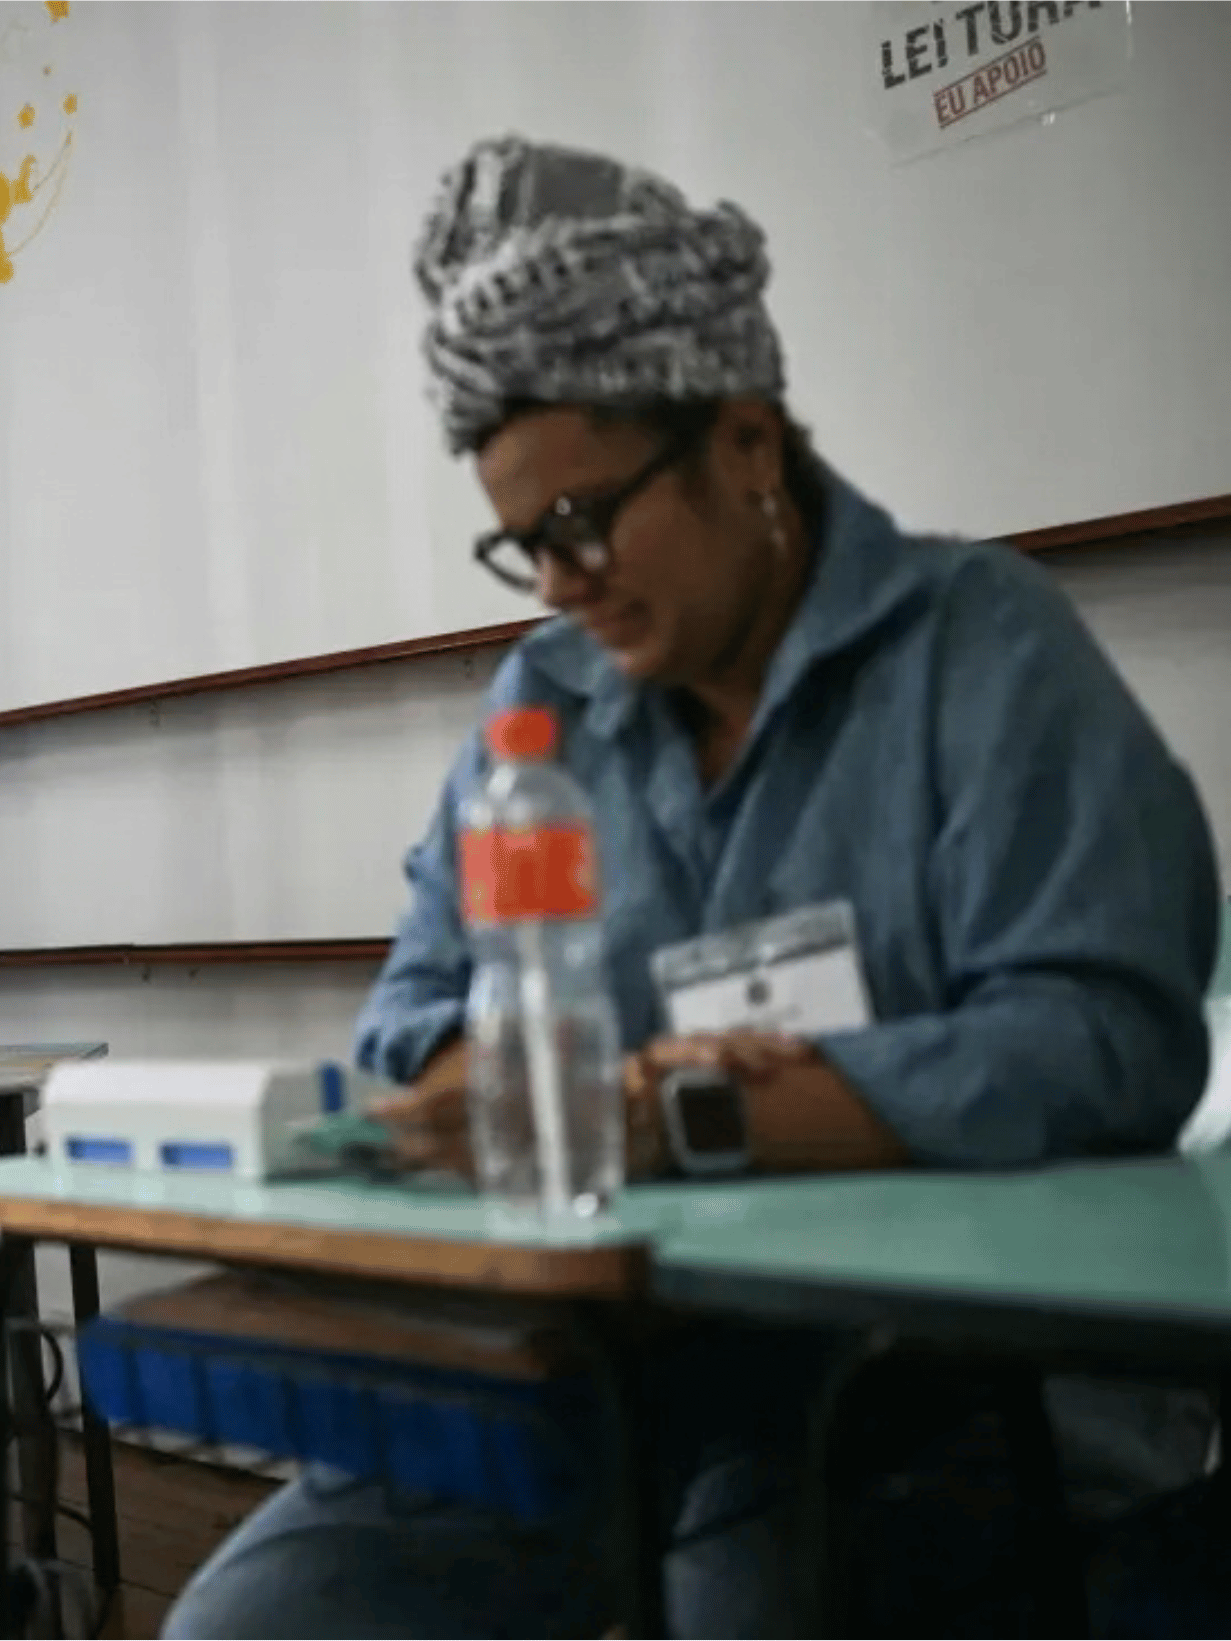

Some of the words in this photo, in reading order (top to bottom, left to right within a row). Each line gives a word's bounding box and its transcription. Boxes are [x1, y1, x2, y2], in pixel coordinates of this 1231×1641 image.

[880, 1, 1103, 89] LEITUR
[935, 86, 966, 124] EU
[973, 41, 1046, 104] APOIO
